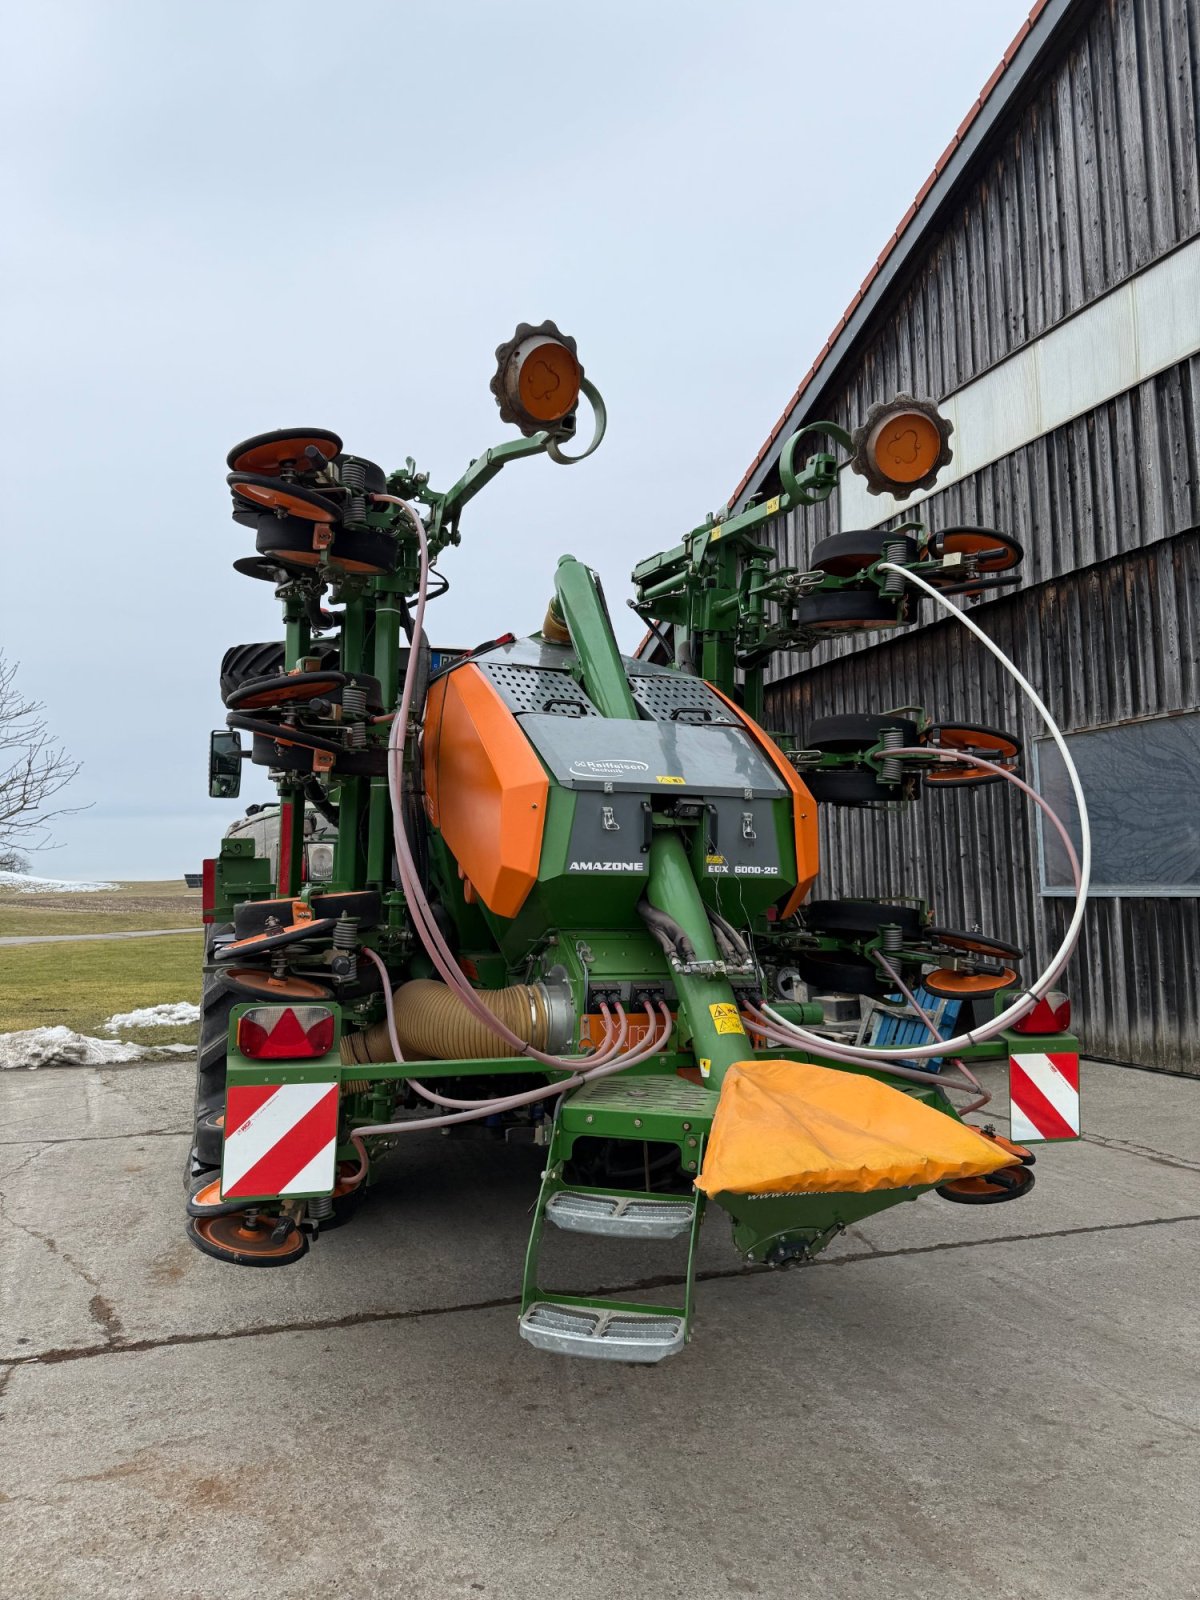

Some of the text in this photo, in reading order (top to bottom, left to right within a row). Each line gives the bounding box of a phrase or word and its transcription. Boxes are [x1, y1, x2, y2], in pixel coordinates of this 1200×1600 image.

[587, 761, 645, 770] Raiffeisen
[569, 861, 644, 871] AMAZONE
[734, 866, 778, 875] 6000-2C
